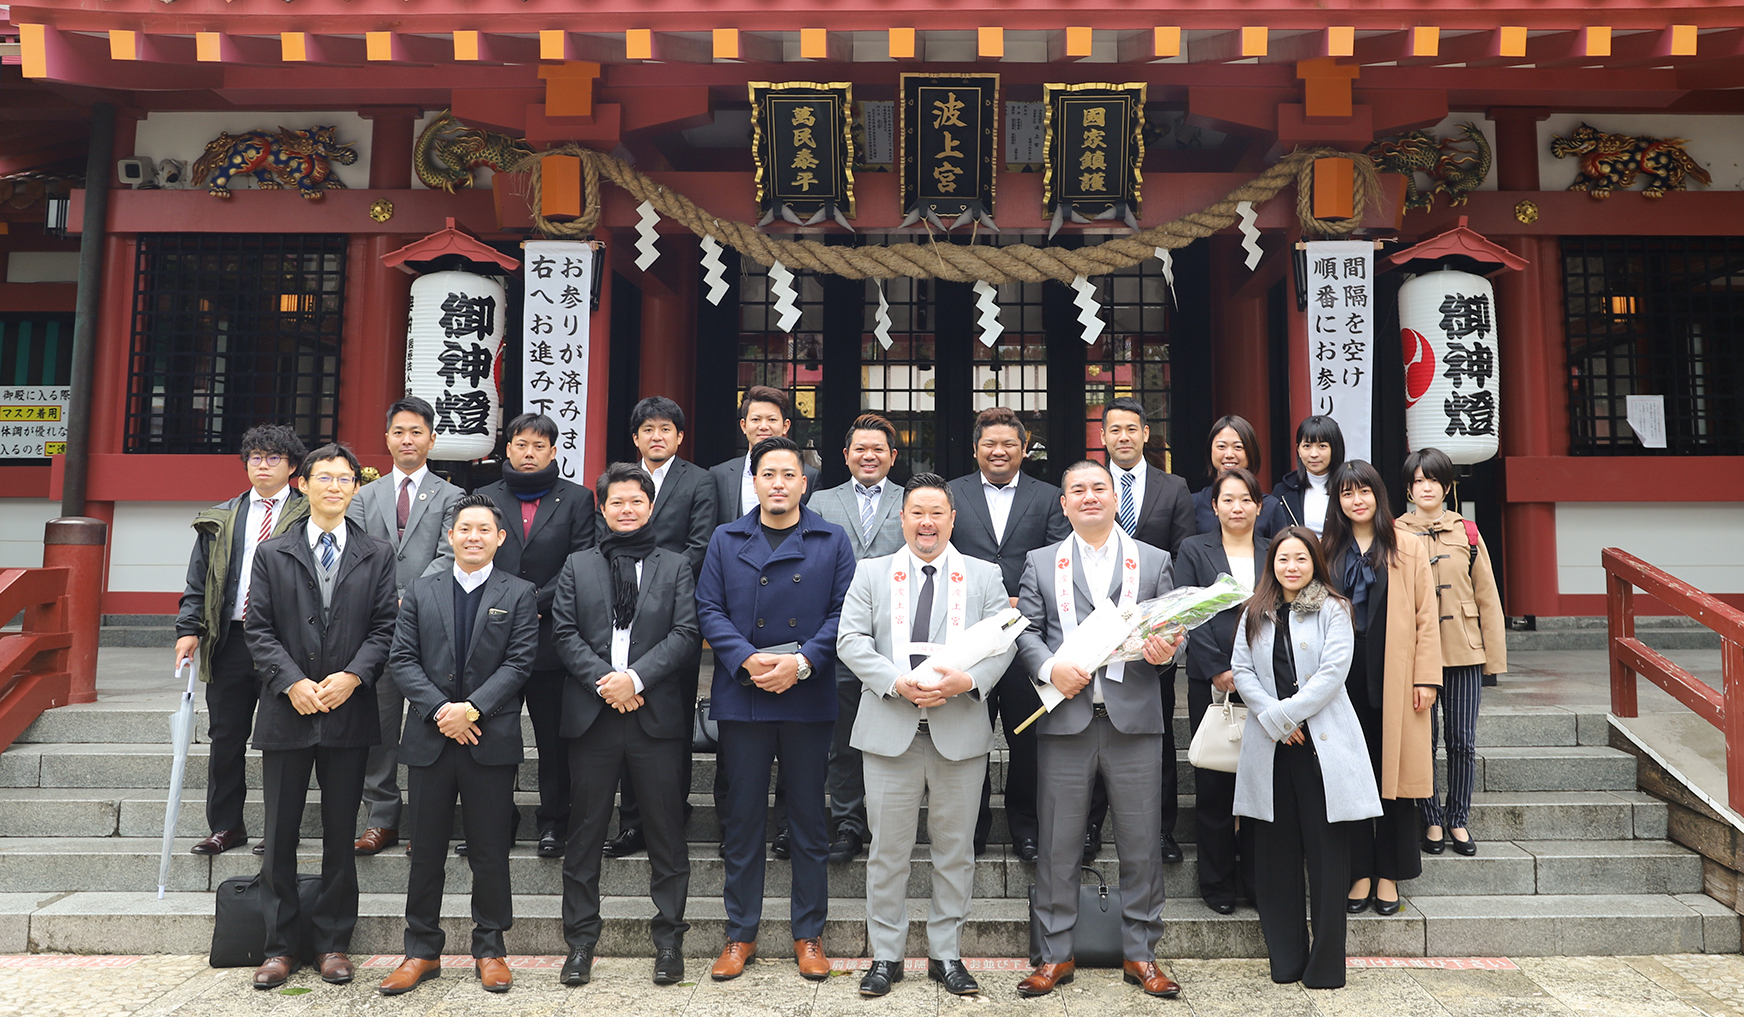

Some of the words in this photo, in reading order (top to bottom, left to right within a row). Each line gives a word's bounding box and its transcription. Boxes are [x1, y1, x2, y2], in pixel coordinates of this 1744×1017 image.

[790, 105, 820, 192] 萬民泰平
[931, 91, 968, 193] 波上宮
[558, 256, 584, 479] お参りが済みまし
[1313, 256, 1340, 416] 順番にお参り
[1341, 256, 1368, 388] 間隔を空け
[1, 425, 68, 437] 体調が優れな
